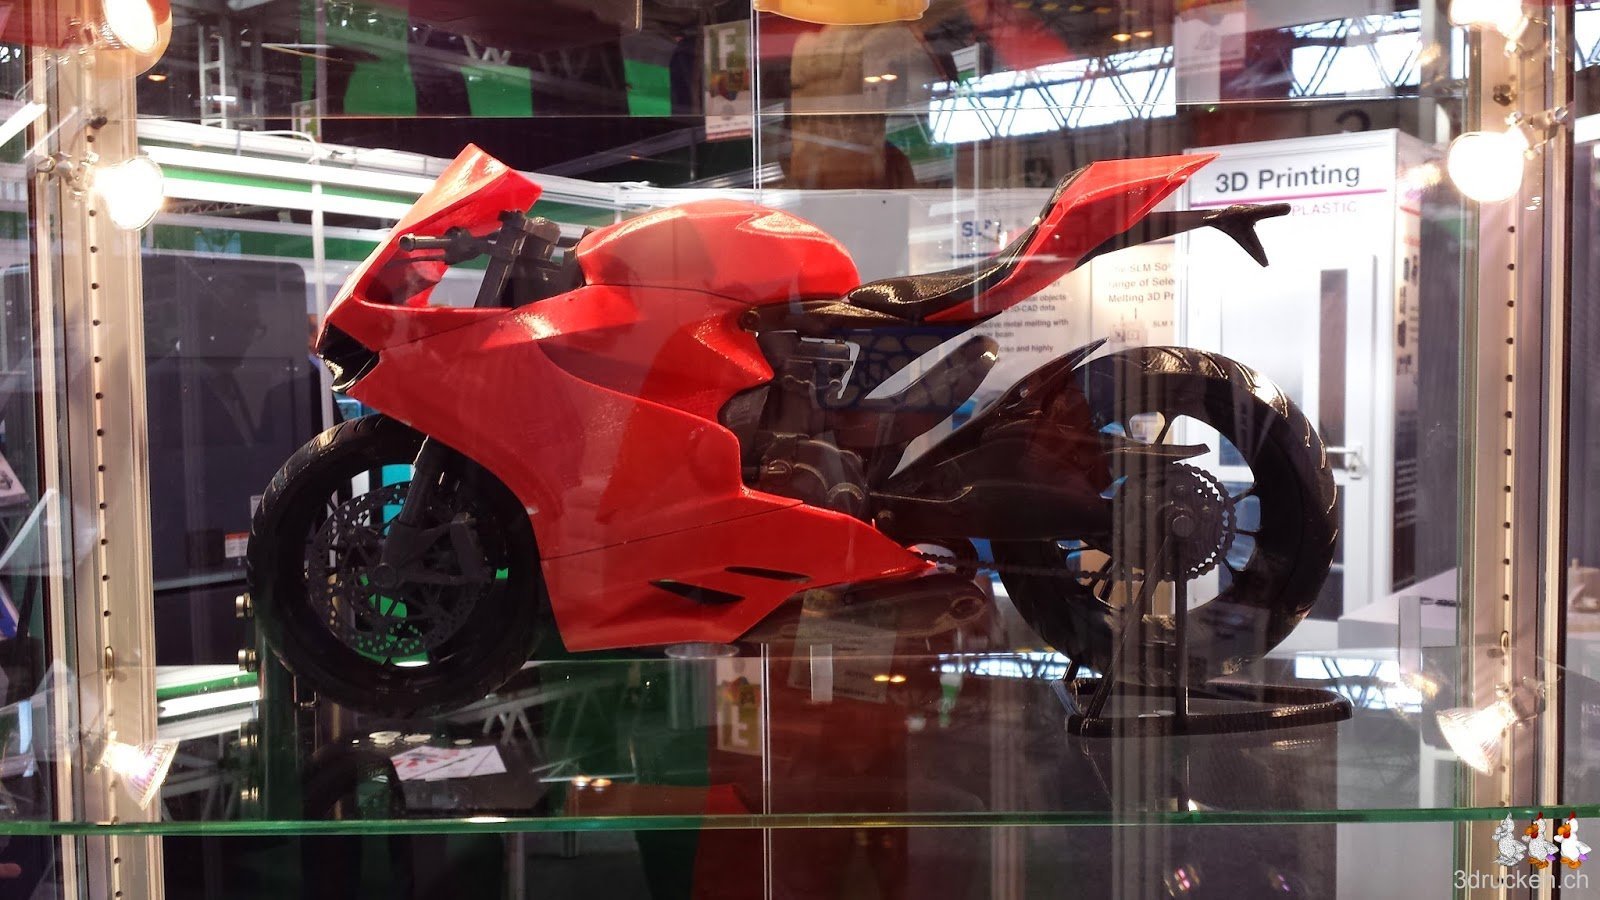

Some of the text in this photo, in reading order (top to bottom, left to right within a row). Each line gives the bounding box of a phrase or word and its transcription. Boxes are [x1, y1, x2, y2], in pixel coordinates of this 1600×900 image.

[1215, 164, 1361, 193] 3D Printing
[1292, 200, 1357, 217] PLASTIC
[1130, 263, 1151, 273] SLM
[1139, 278, 1149, 287] of
[1039, 293, 1066, 303] objects
[1108, 294, 1144, 304] Melting
[1147, 292, 1161, 301] 3D
[1040, 303, 1056, 311] data
[1003, 320, 1022, 328] metal
[1025, 319, 1051, 329] melting
[1053, 318, 1069, 326] with
[995, 330, 1014, 338] beam
[1016, 344, 1030, 353] and
[1031, 343, 1053, 353] highly
